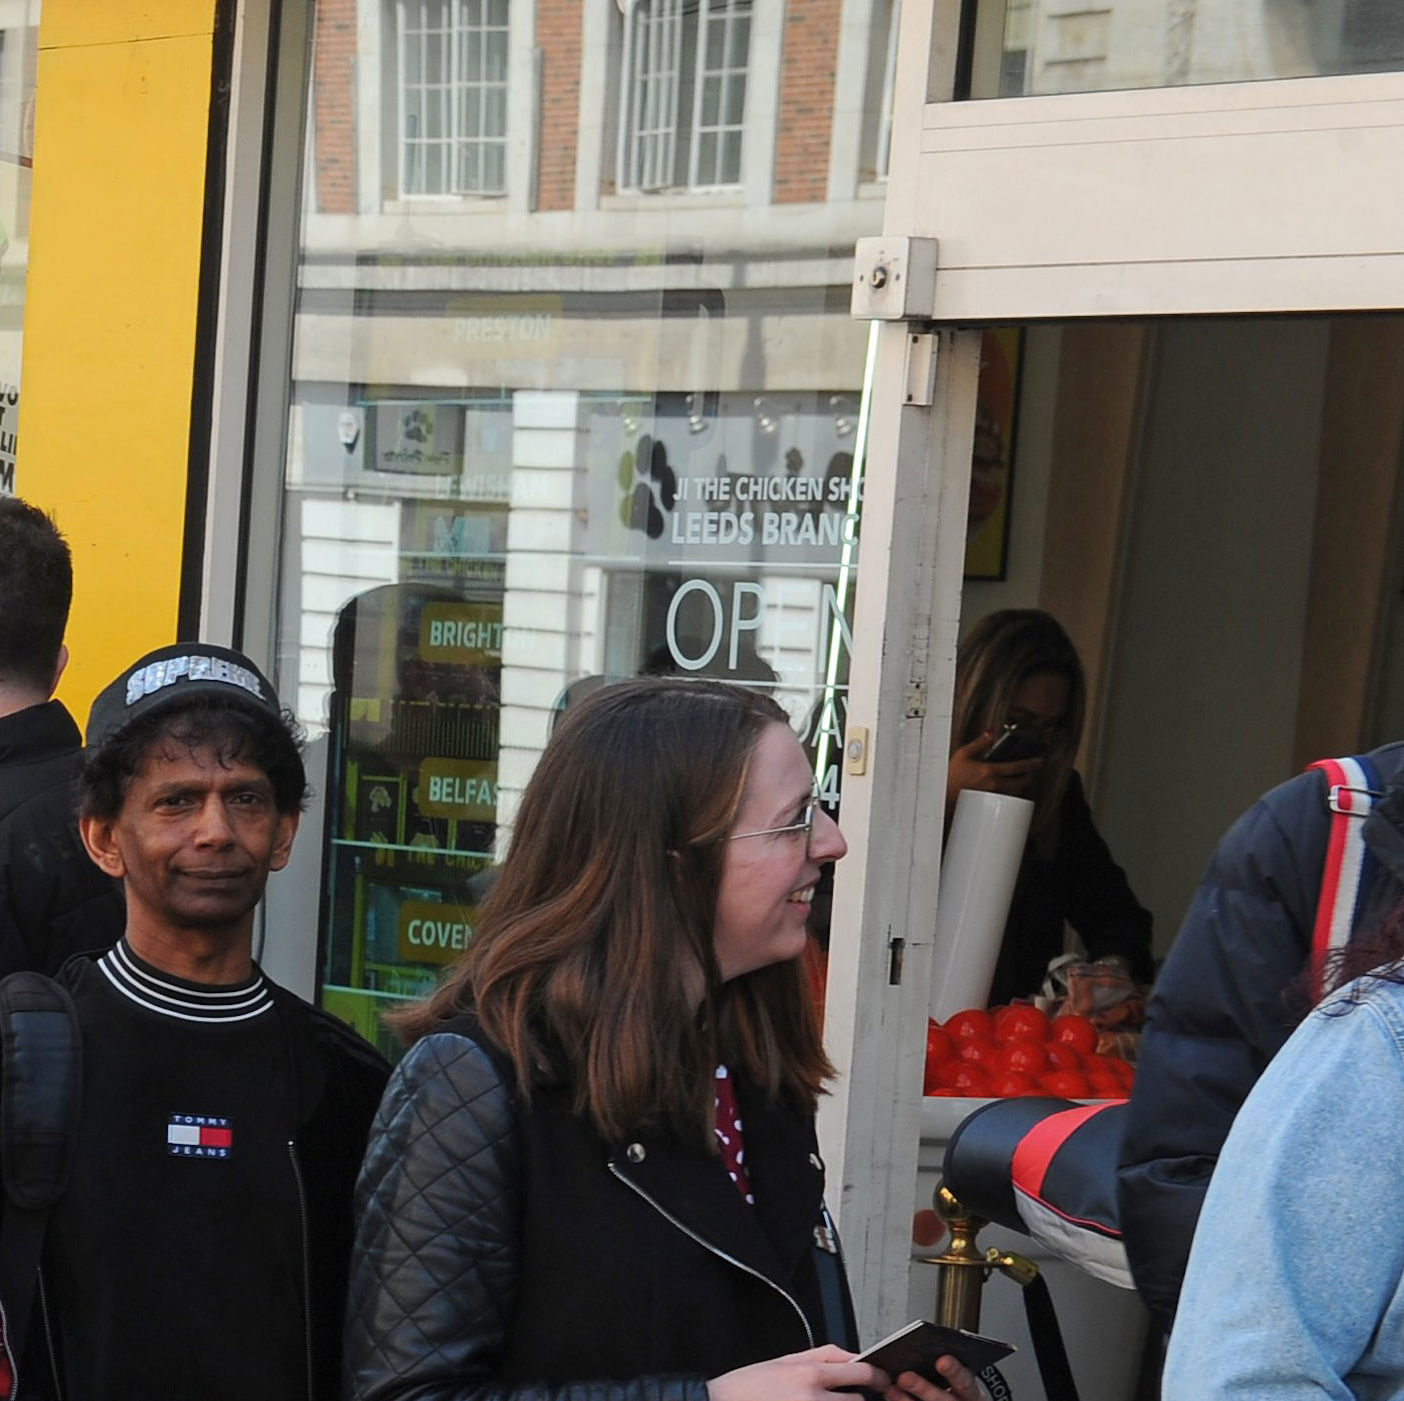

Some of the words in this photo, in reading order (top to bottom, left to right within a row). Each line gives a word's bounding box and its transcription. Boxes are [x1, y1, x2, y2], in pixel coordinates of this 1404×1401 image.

[453, 314, 551, 343] PRESTON
[694, 477, 731, 501] THE
[735, 477, 823, 501] CHICKEN
[671, 511, 755, 545] LEEDS
[173, 1115, 228, 1126] TOMMY
[172, 1146, 226, 1157] JEANS
